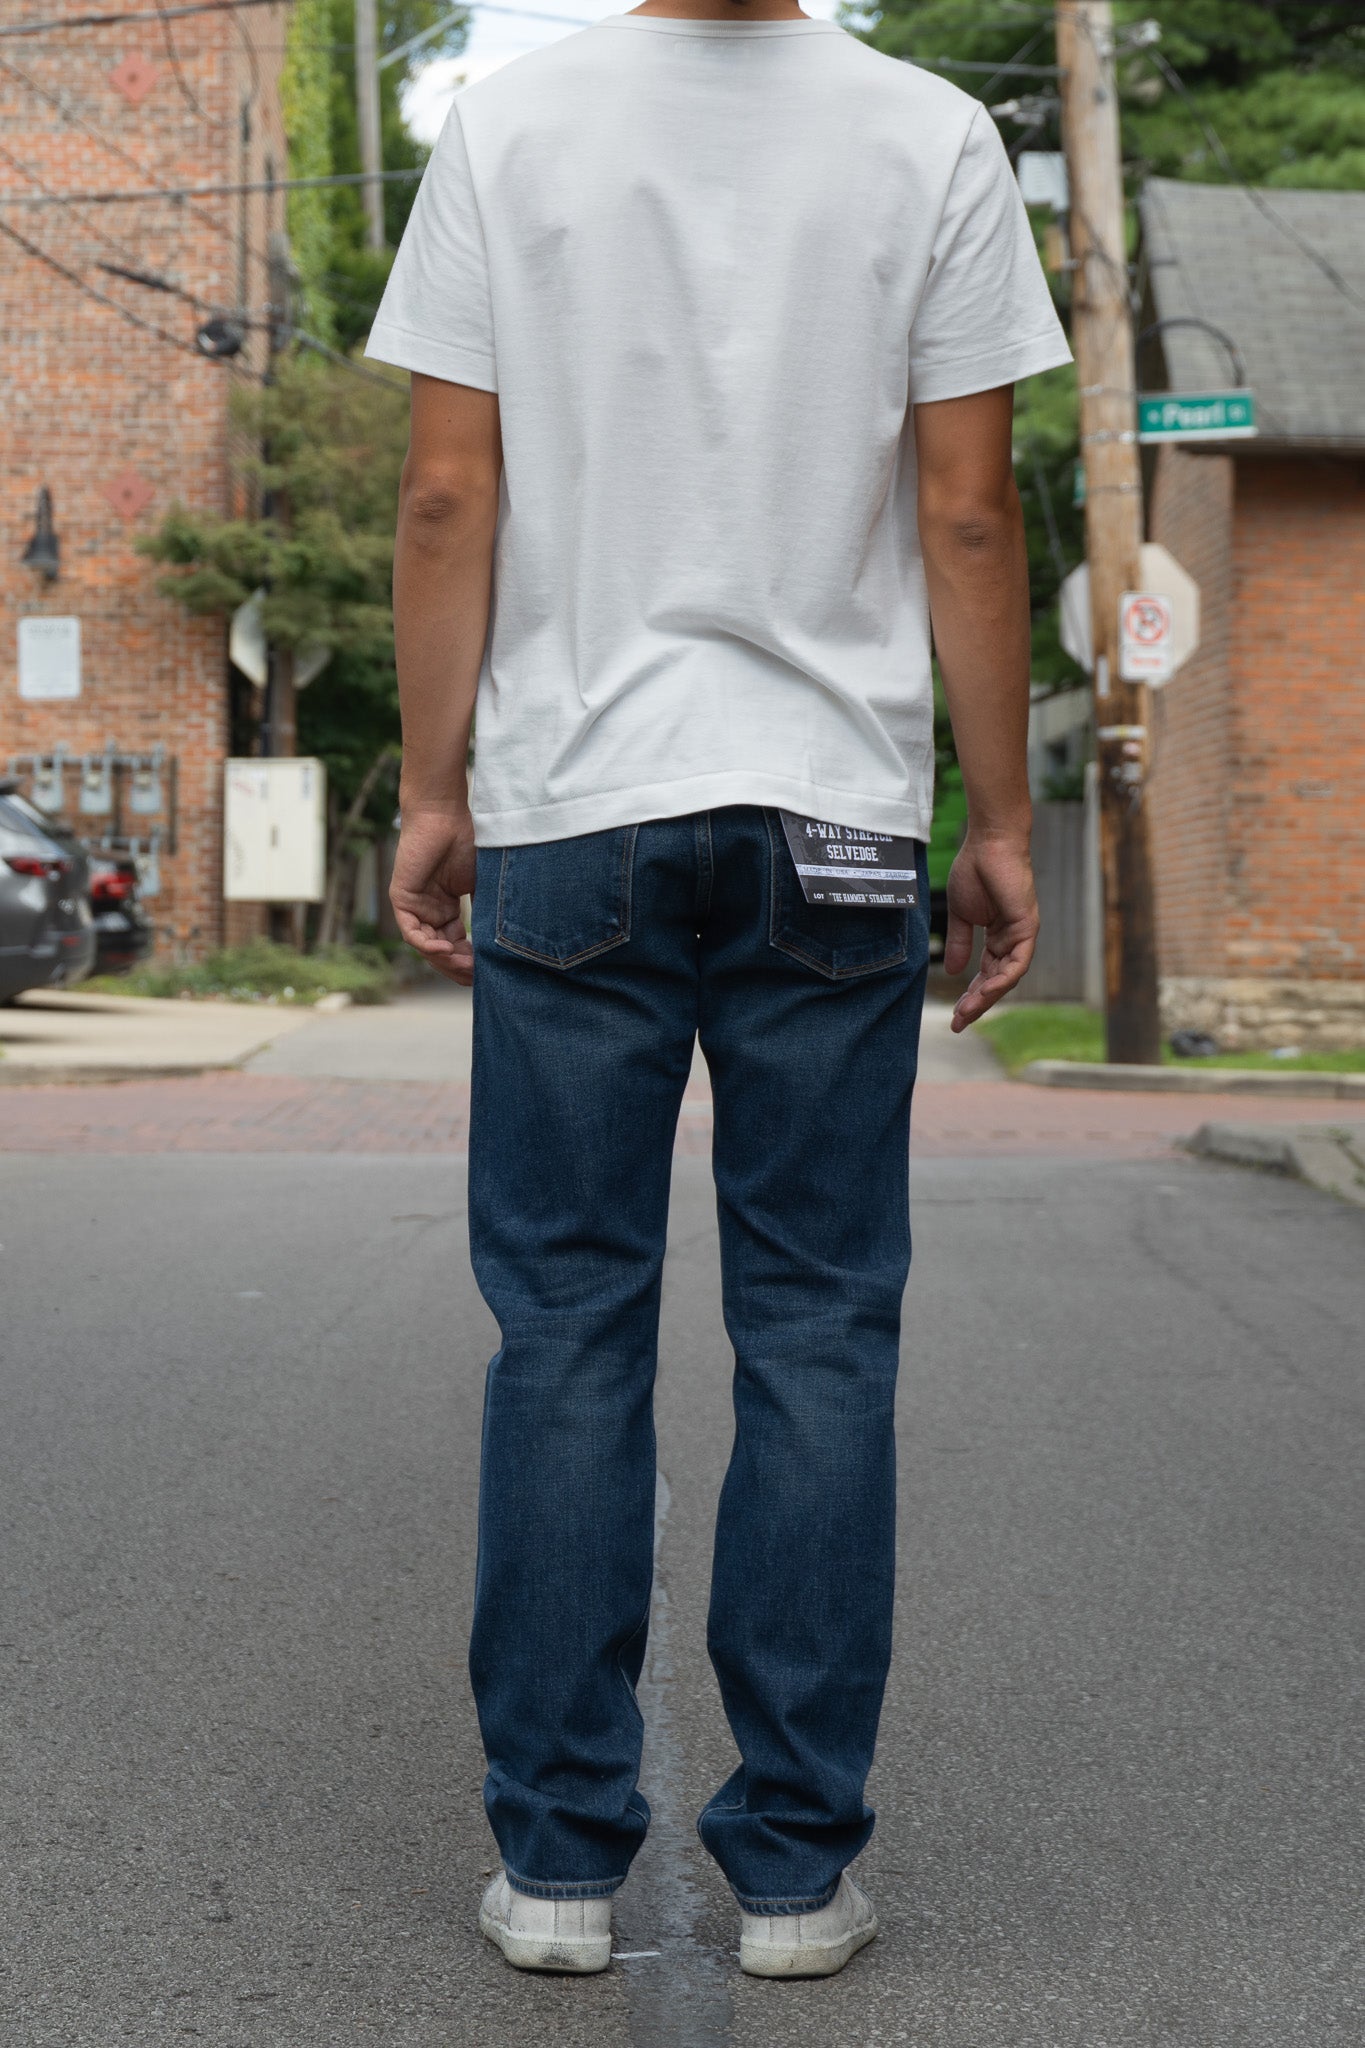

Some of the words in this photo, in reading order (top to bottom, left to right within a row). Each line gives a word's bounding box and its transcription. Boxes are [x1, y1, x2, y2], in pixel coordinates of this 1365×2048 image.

[1162, 401, 1225, 429] Pearl
[806, 823, 841, 839] 4-WAY
[827, 845, 878, 861] SELVEDGE
[869, 894, 895, 903] STRAIGHT
